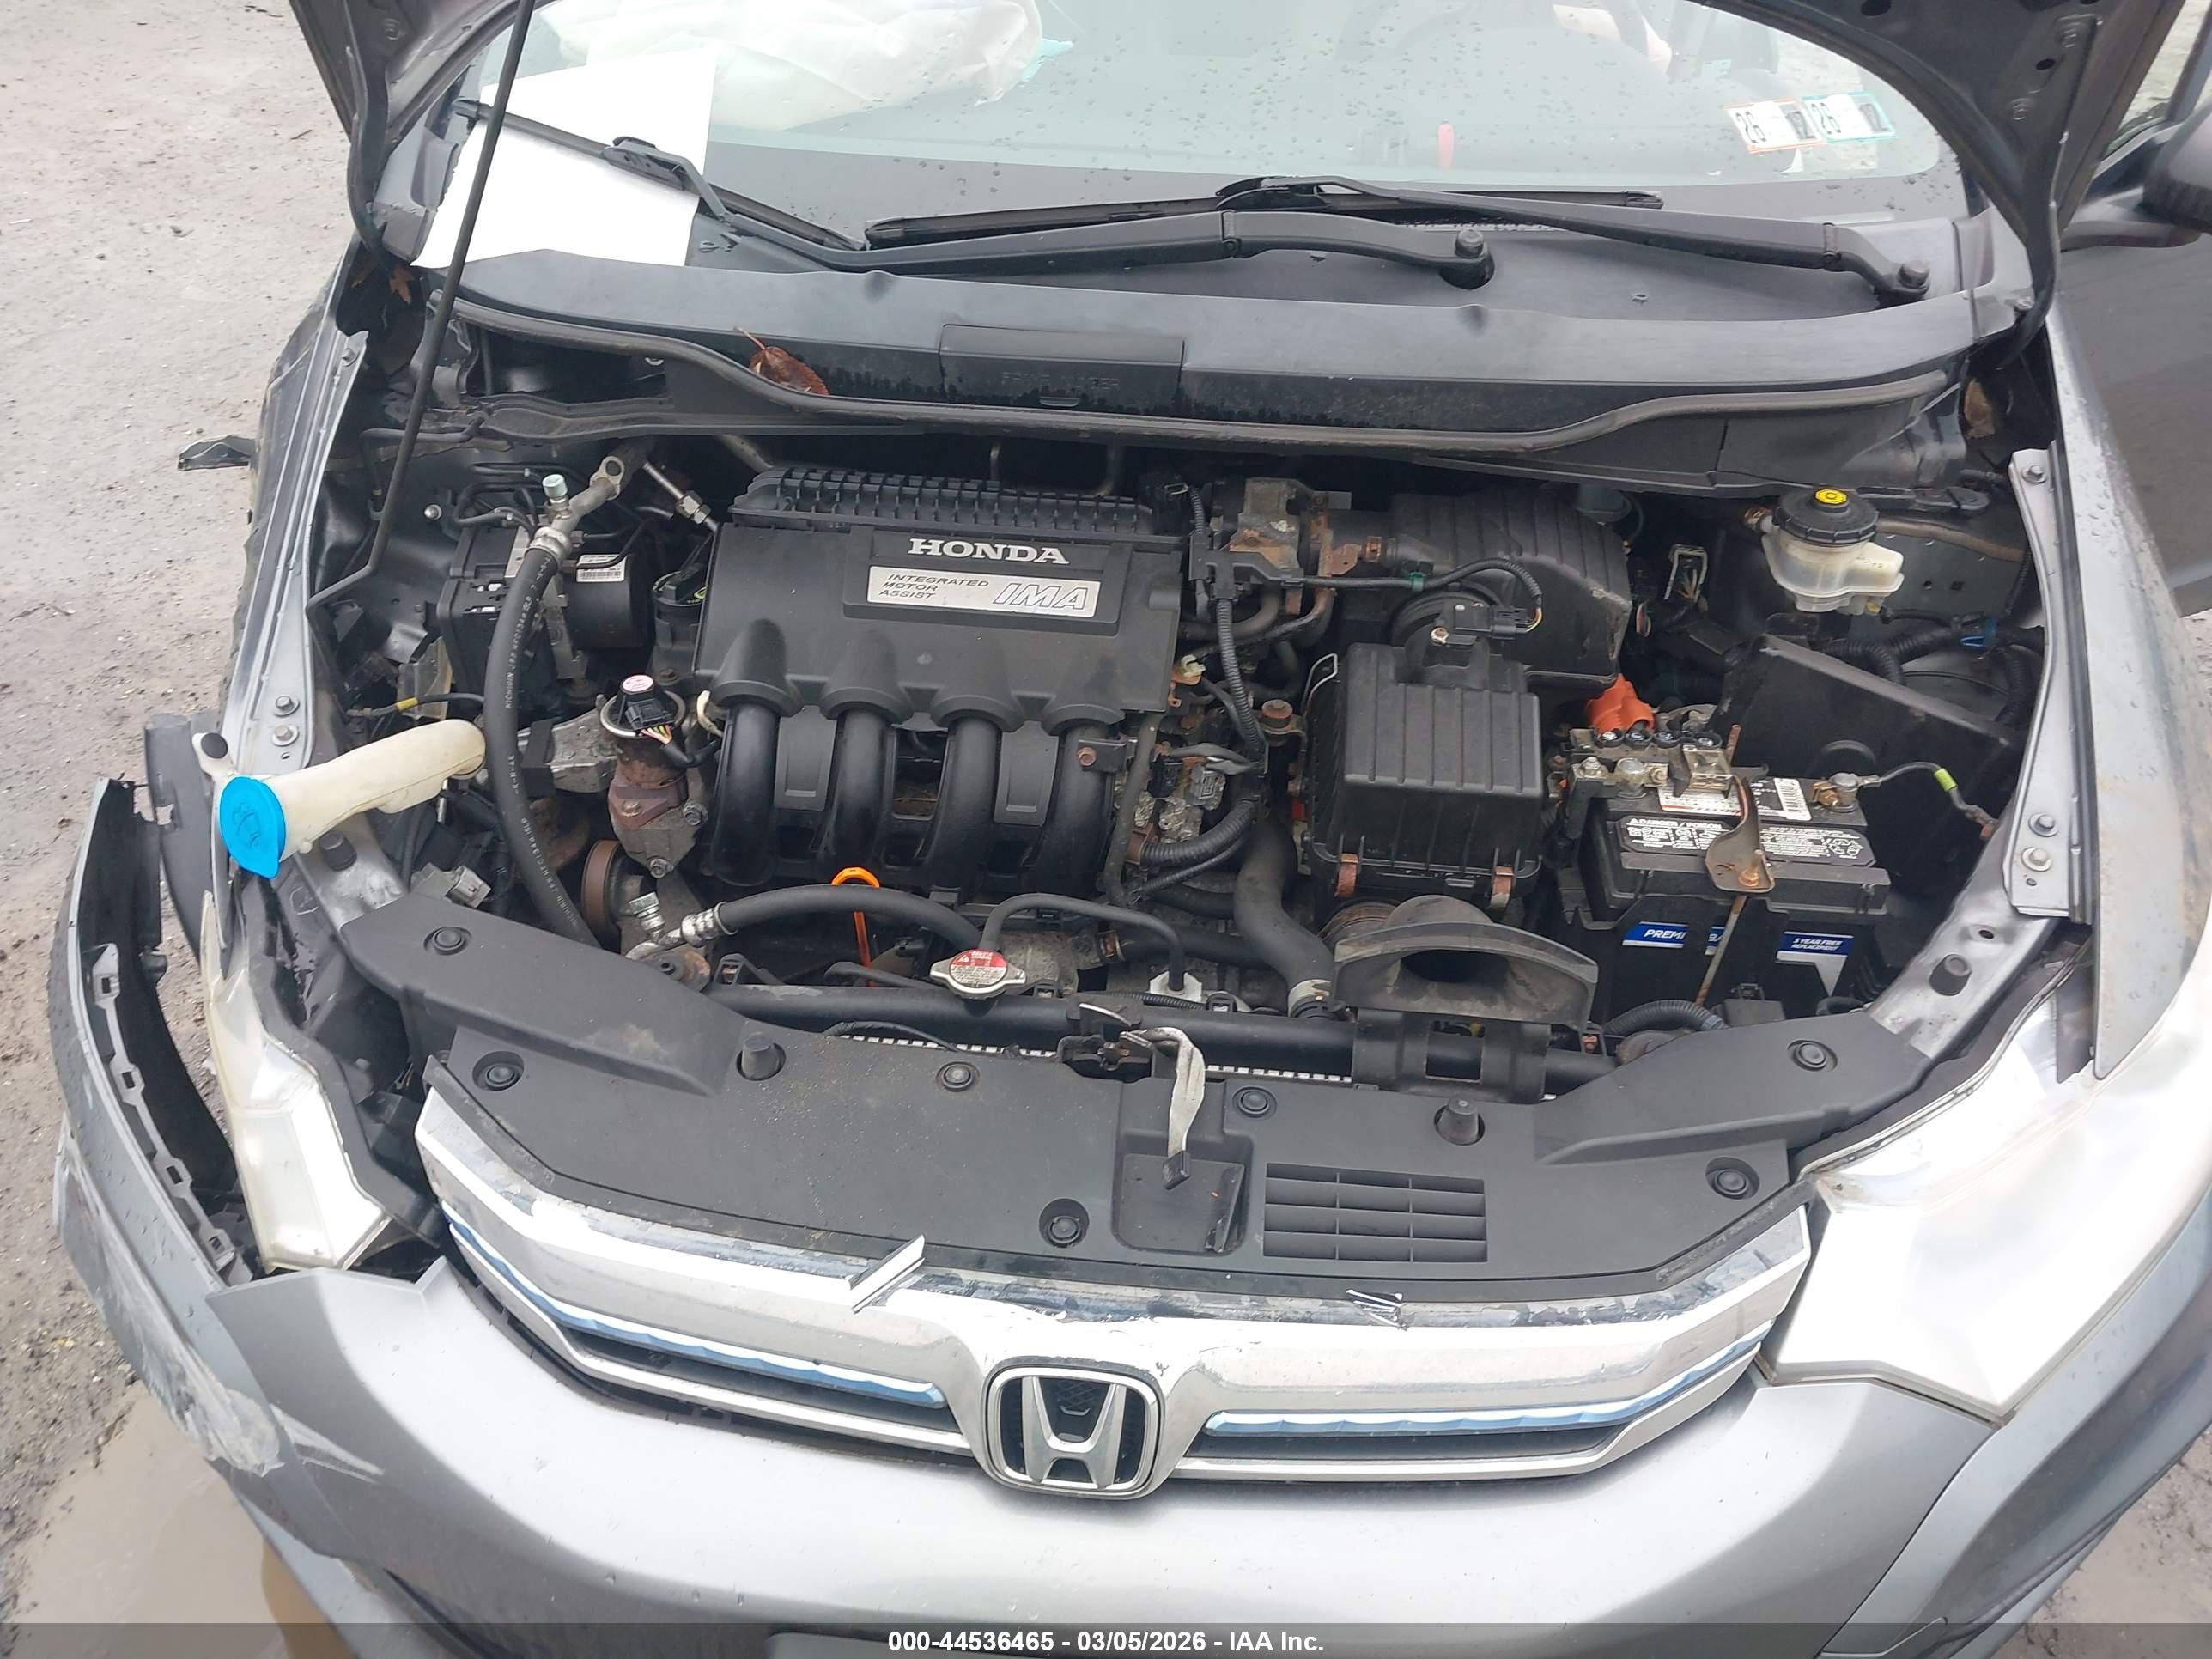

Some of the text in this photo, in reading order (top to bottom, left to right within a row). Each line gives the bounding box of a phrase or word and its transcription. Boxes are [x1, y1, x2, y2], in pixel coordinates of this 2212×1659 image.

[907, 538, 1071, 565] HONDA
[887, 574, 990, 587] INTEGRATED
[882, 582, 939, 592] MOTOR
[879, 589, 937, 599] ASSIST
[992, 582, 1089, 611] IMA
[1644, 929, 1687, 939] PREMI
